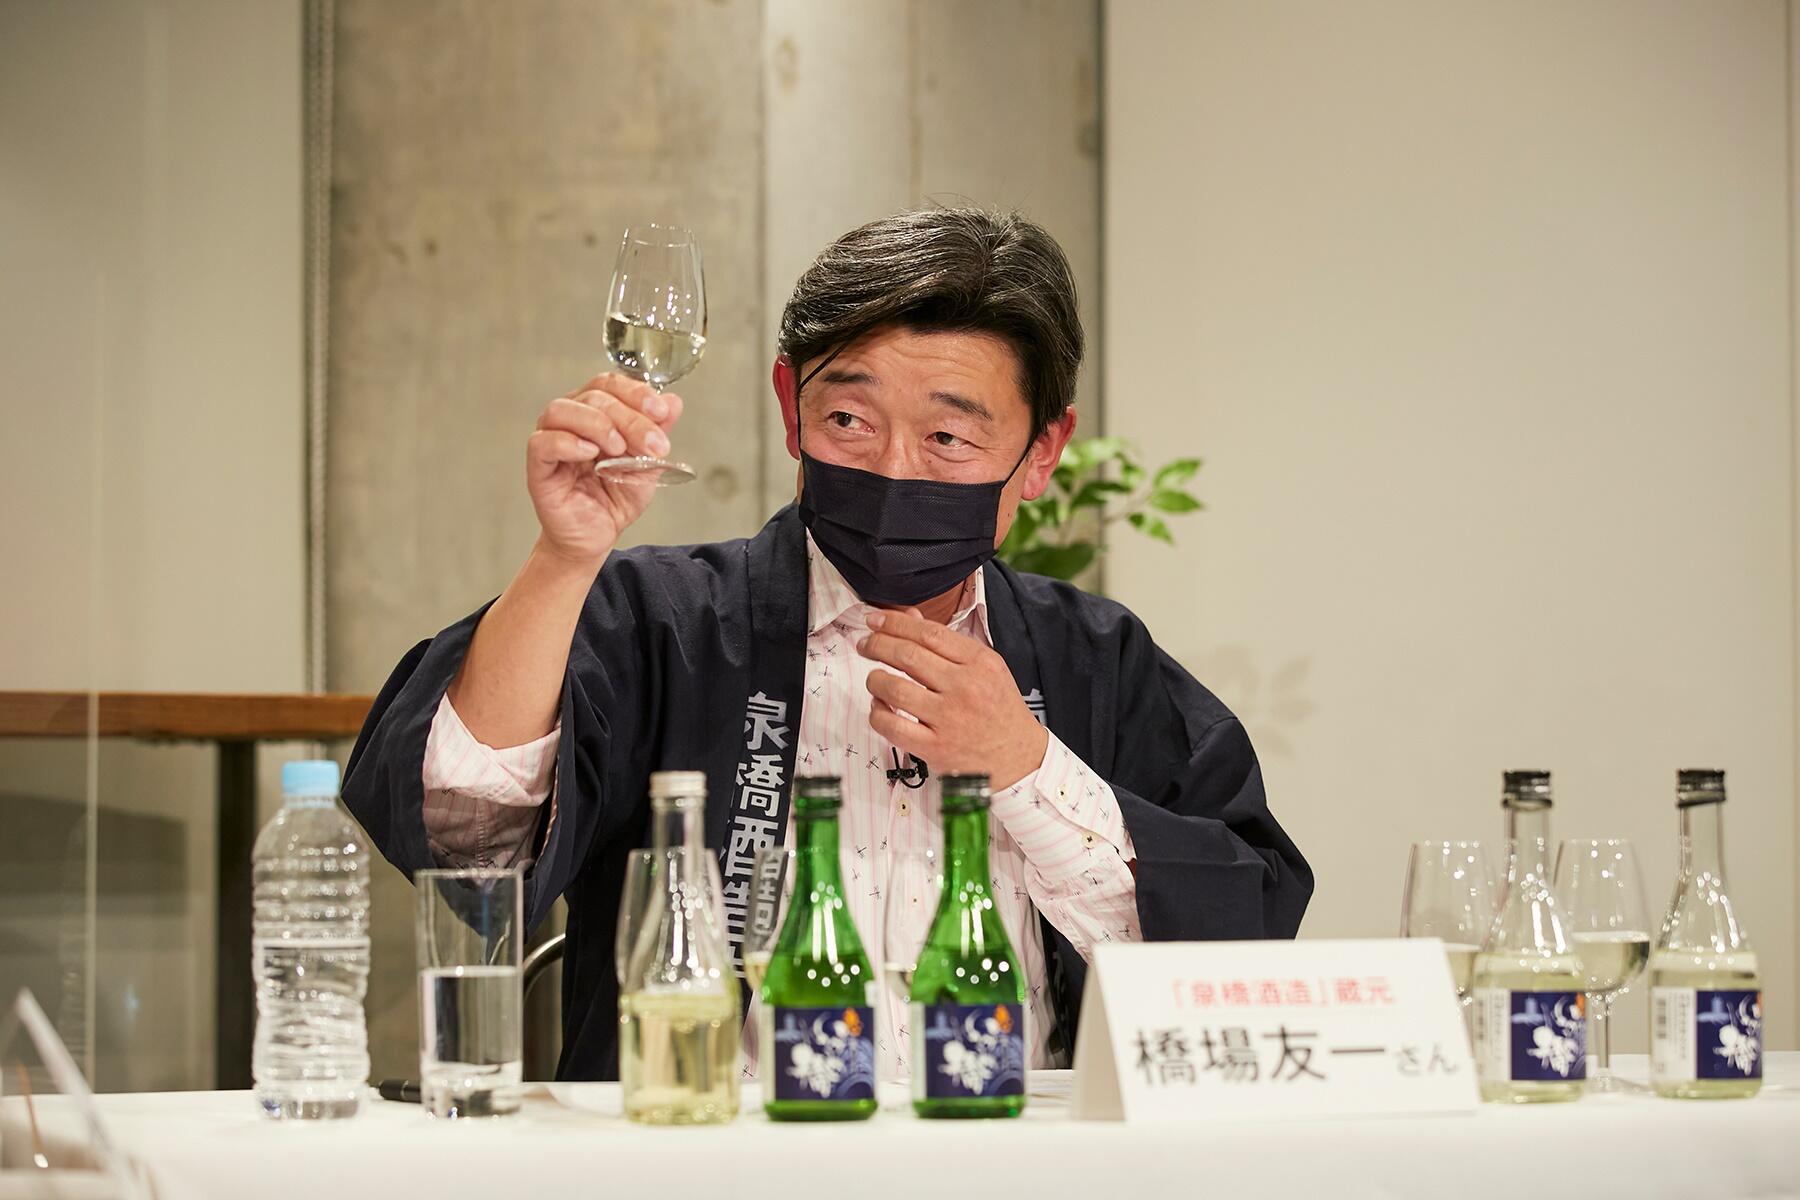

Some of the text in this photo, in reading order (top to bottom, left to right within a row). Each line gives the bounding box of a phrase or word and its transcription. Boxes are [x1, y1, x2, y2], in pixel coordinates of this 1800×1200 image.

[1131, 1025, 1458, 1085] 橋場友一さん
